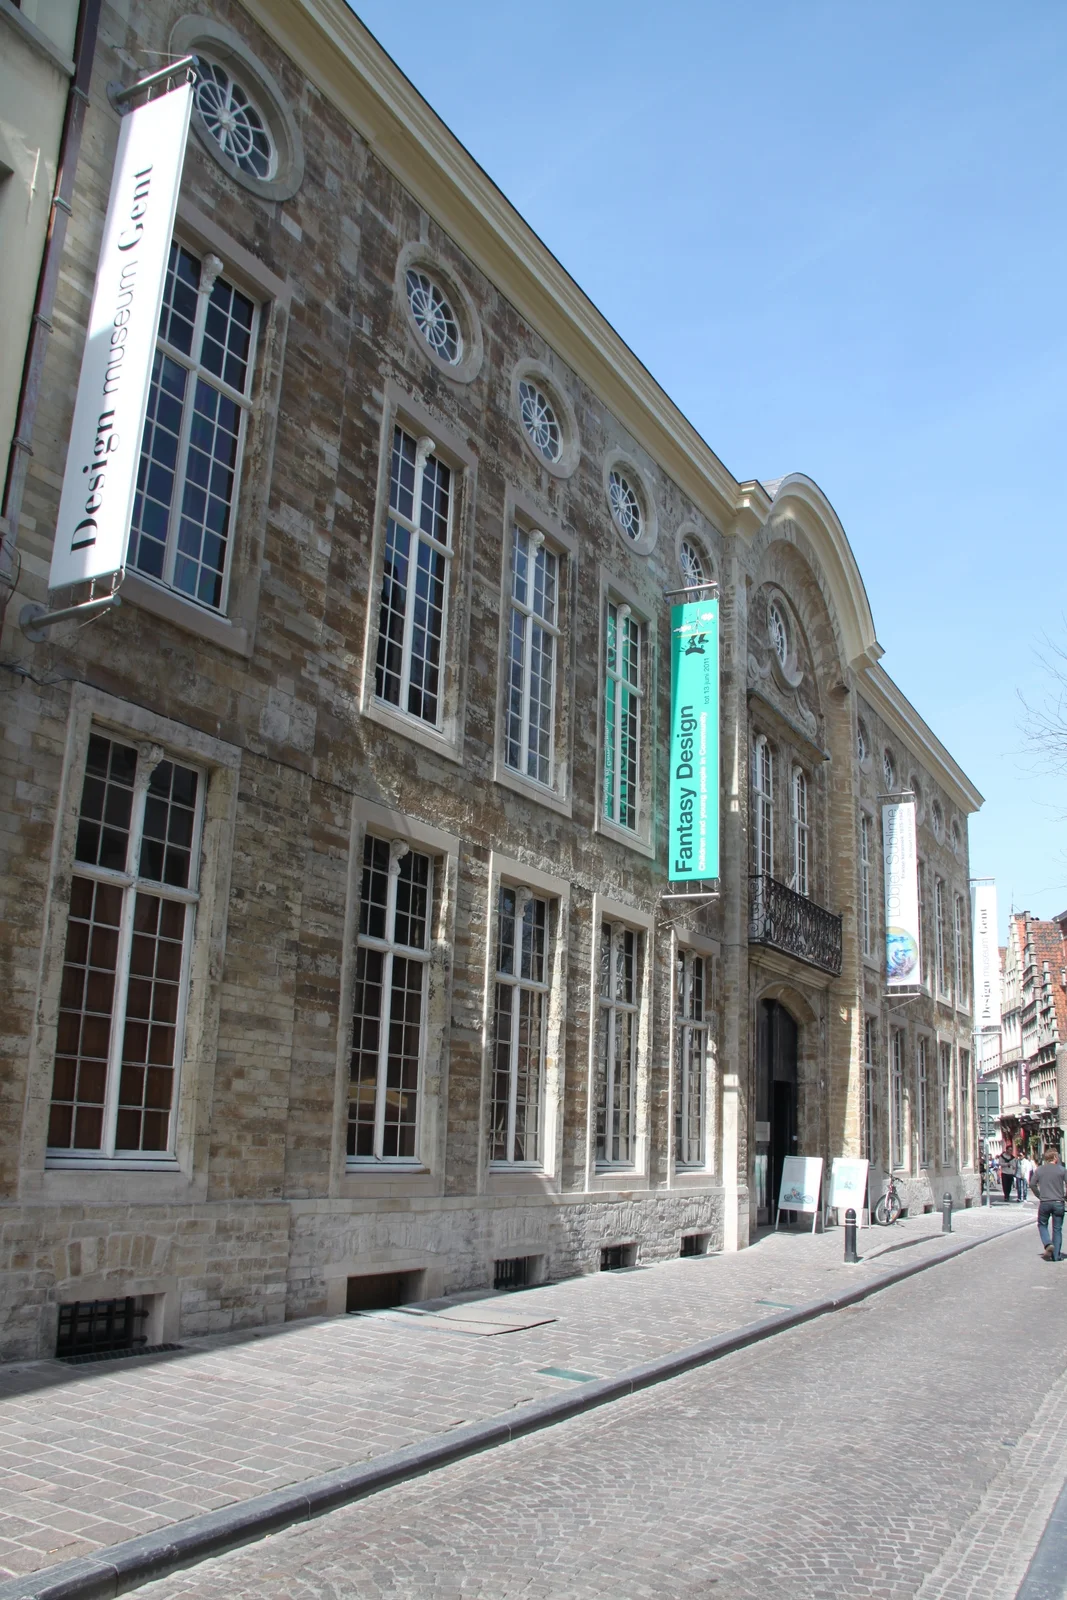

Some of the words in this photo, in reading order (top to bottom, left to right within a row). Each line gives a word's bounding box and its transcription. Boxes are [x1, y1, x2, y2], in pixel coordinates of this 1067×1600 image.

[117, 163, 153, 252] Gent
[102, 260, 138, 396] museum
[70, 406, 120, 556] Design
[704, 686, 710, 694] 13
[676, 705, 697, 780] Design
[698, 711, 708, 756] Community
[698, 757, 707, 765] in
[699, 766, 708, 793] people
[699, 795, 708, 819] young
[675, 787, 697, 873] Fantasy
[698, 821, 707, 836] and
[698, 837, 707, 871] Children
[886, 869, 902, 917] L'Objet
[979, 909, 988, 935] Gent
[981, 938, 990, 977] museum
[981, 980, 991, 1019] Design
